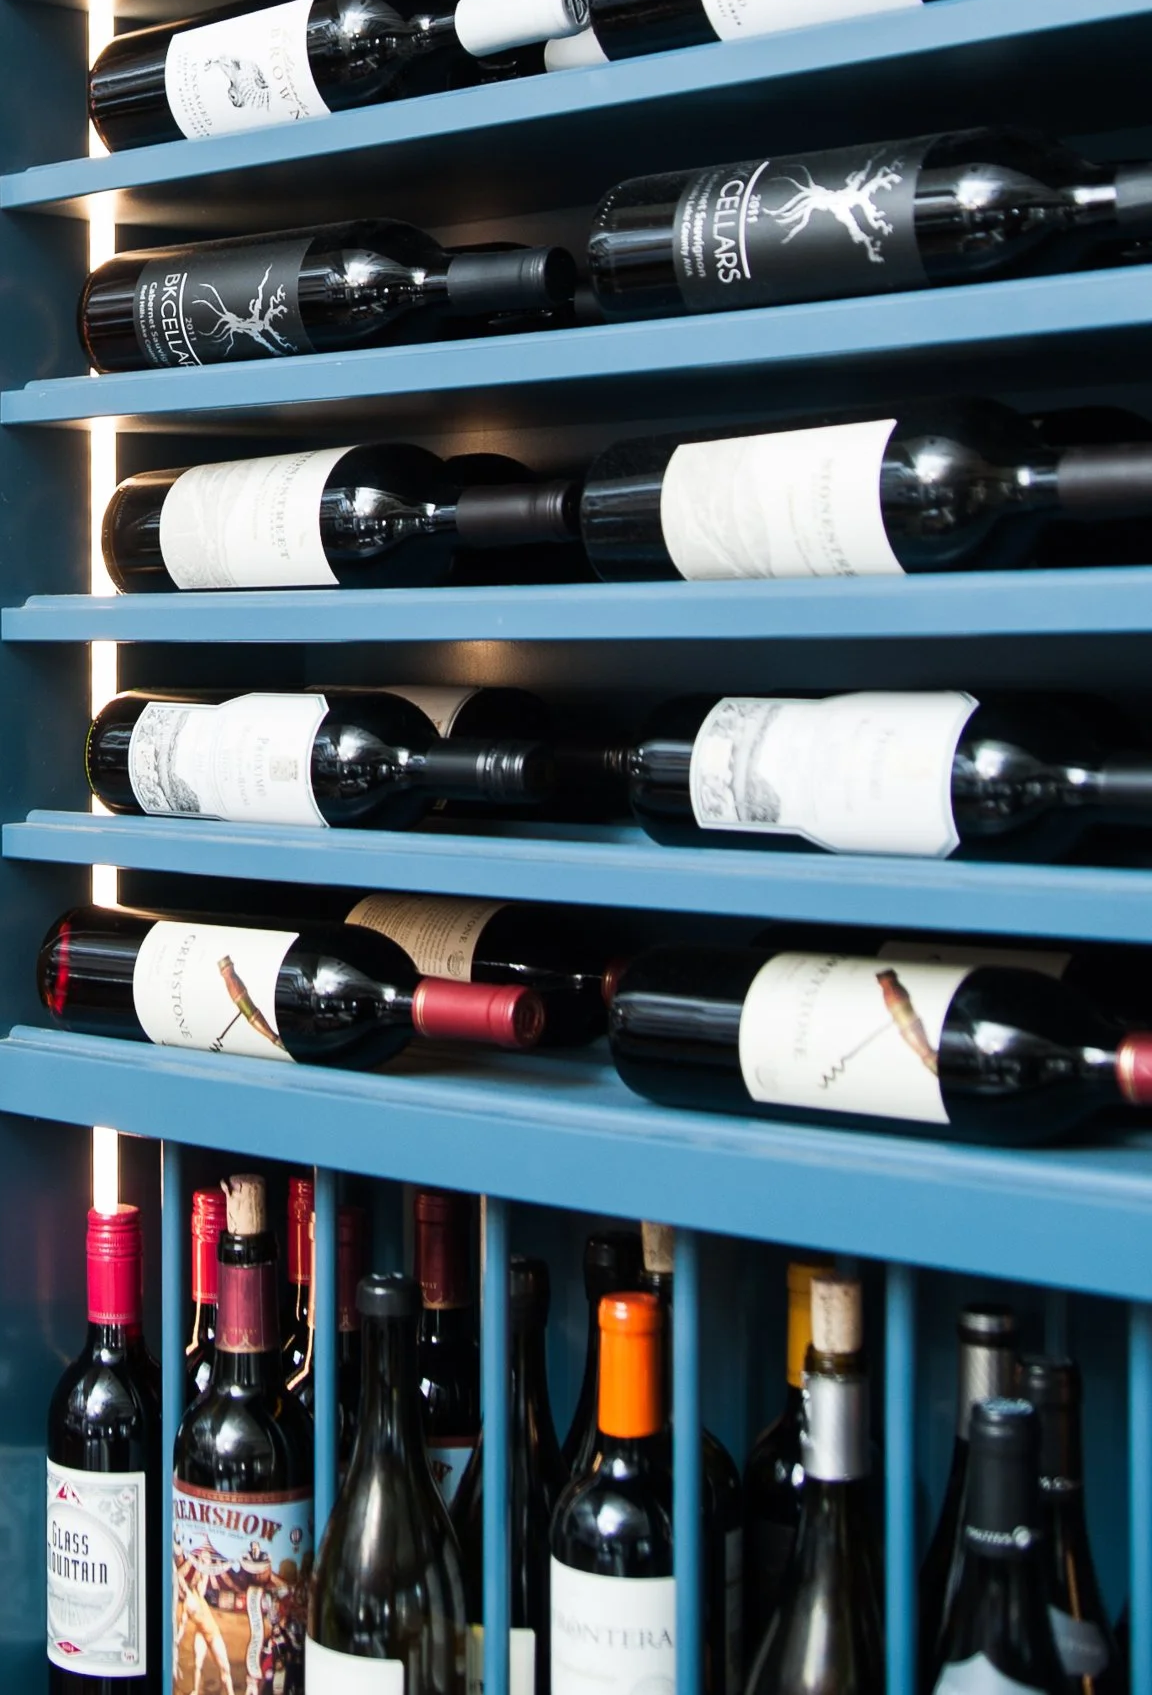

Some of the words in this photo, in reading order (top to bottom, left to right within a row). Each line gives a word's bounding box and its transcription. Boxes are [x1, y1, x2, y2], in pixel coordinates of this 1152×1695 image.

[147, 281, 158, 328] Cabernet
[185, 317, 197, 341] 2011
[171, 934, 196, 1039] GREYSTONE
[52, 1519, 90, 1556] GLASS
[173, 1497, 283, 1544] REAKSHOW
